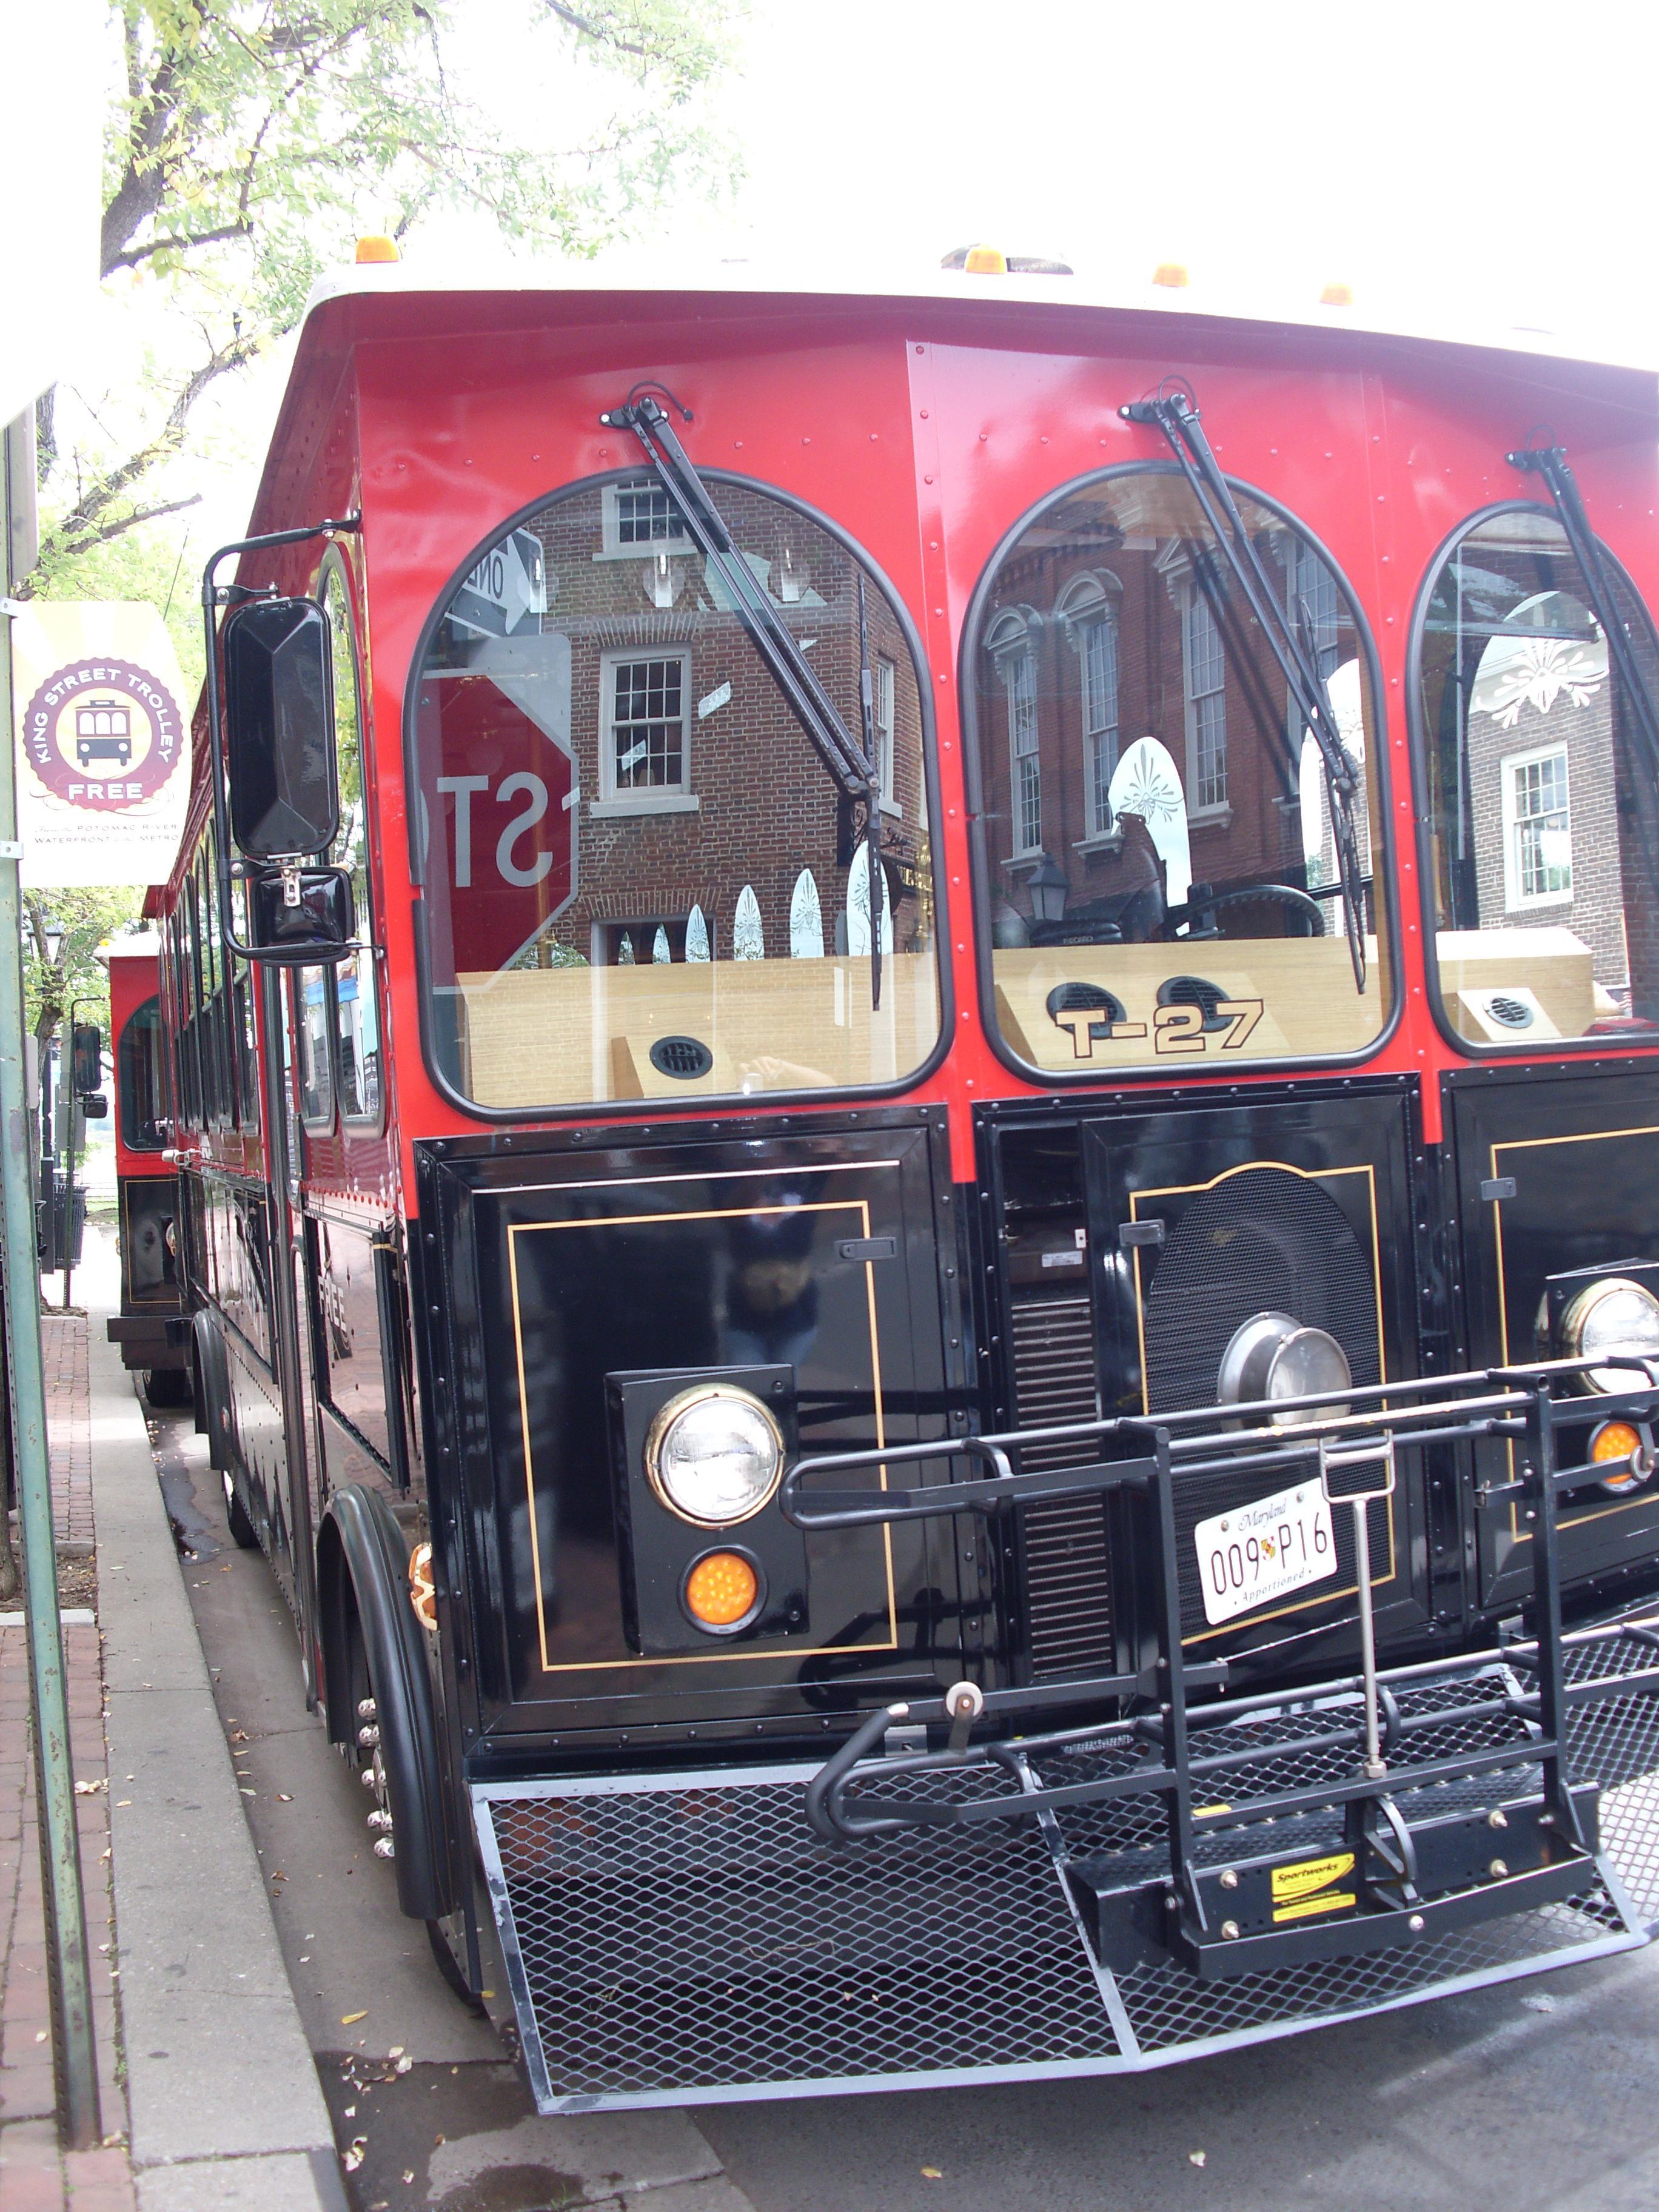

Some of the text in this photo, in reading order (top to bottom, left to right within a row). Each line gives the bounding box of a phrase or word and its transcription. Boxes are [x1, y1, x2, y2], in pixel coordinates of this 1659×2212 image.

[33, 668, 174, 764] KING STREET TROLLEY
[68, 783, 144, 800] FREE
[1055, 999, 1264, 1059] T-27
[318, 1275, 347, 1333] FREE
[1238, 1498, 1287, 1532] Maryland
[1210, 1512, 1327, 1595] 009 P16
[1242, 1569, 1305, 1602] Apportioned
[1277, 1863, 1339, 1883] Sportworks
